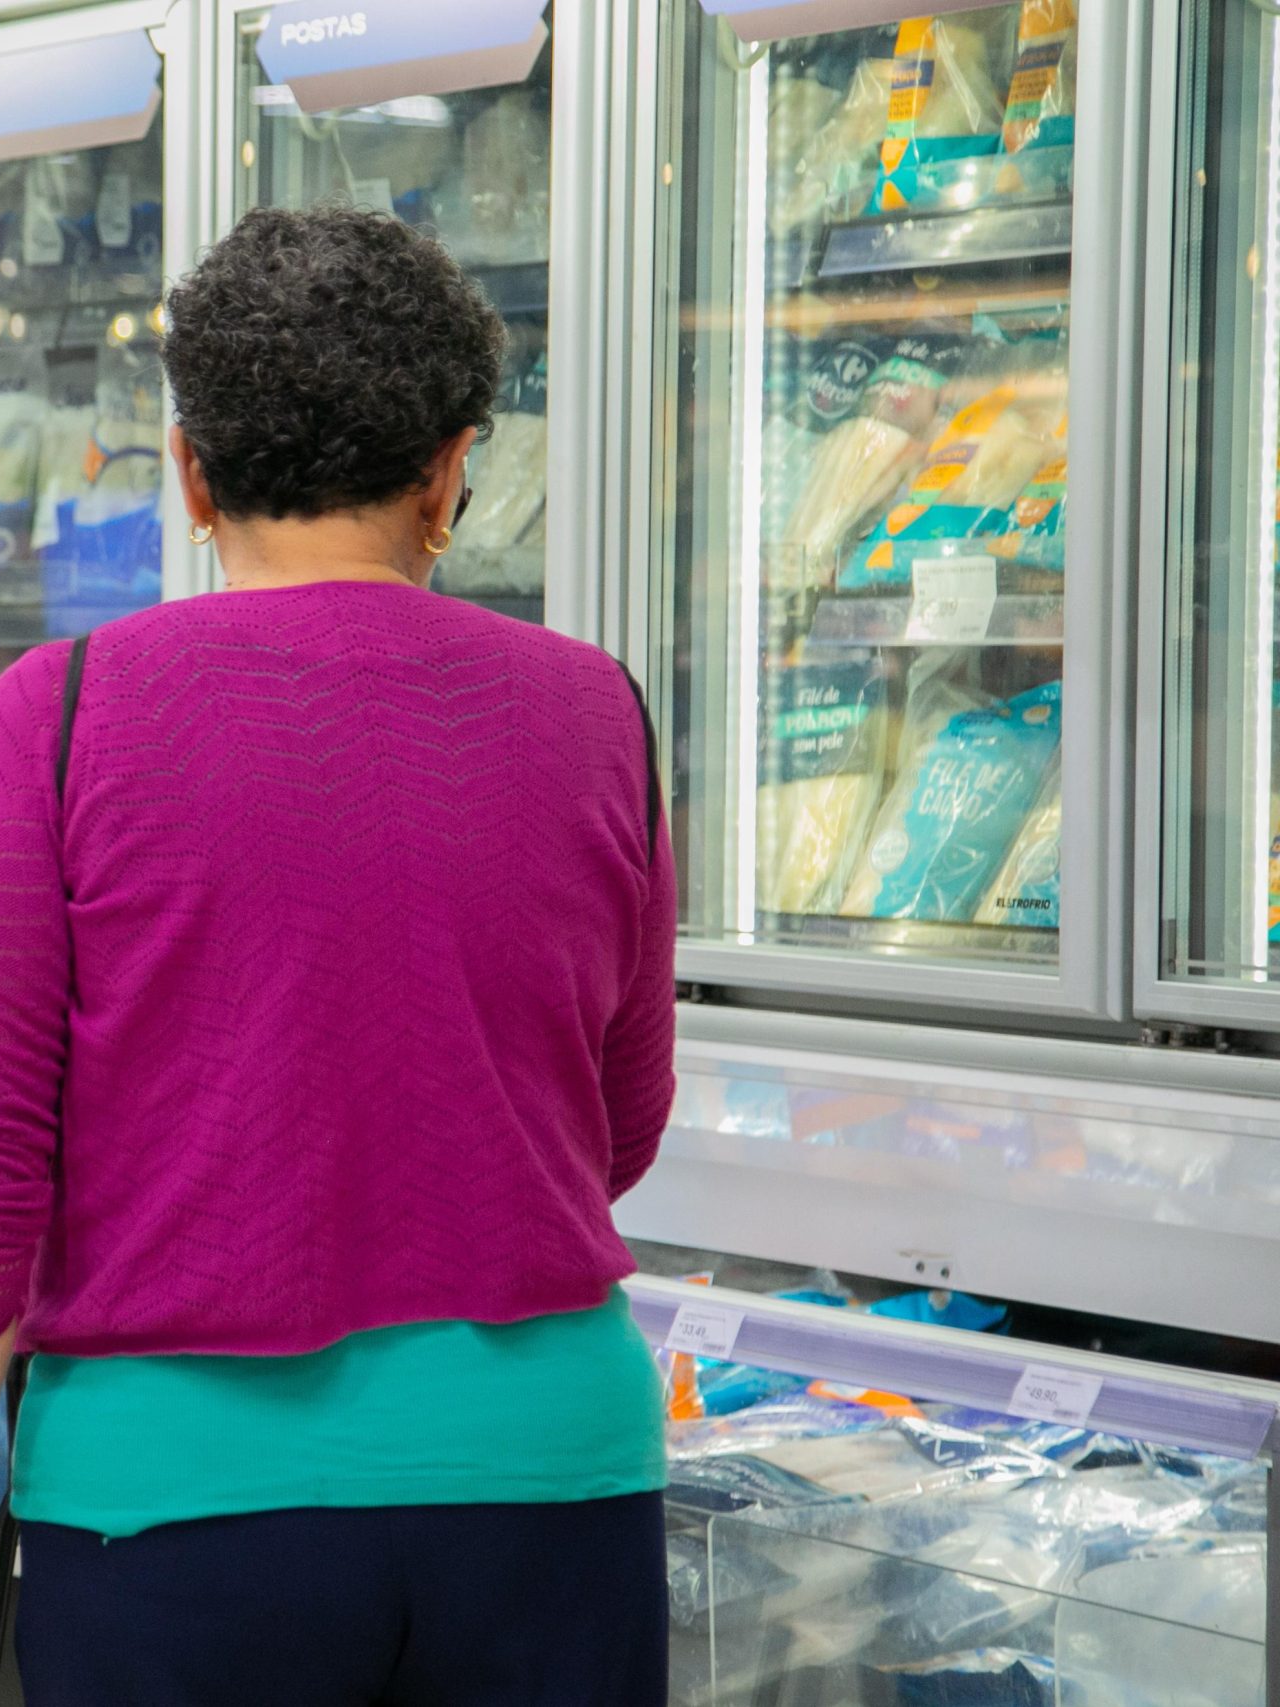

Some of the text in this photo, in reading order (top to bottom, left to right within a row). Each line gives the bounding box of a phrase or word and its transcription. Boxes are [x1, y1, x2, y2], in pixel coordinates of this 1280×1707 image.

[281, 12, 367, 47] POSTAS
[823, 684, 840, 704] de
[818, 730, 844, 755] pele
